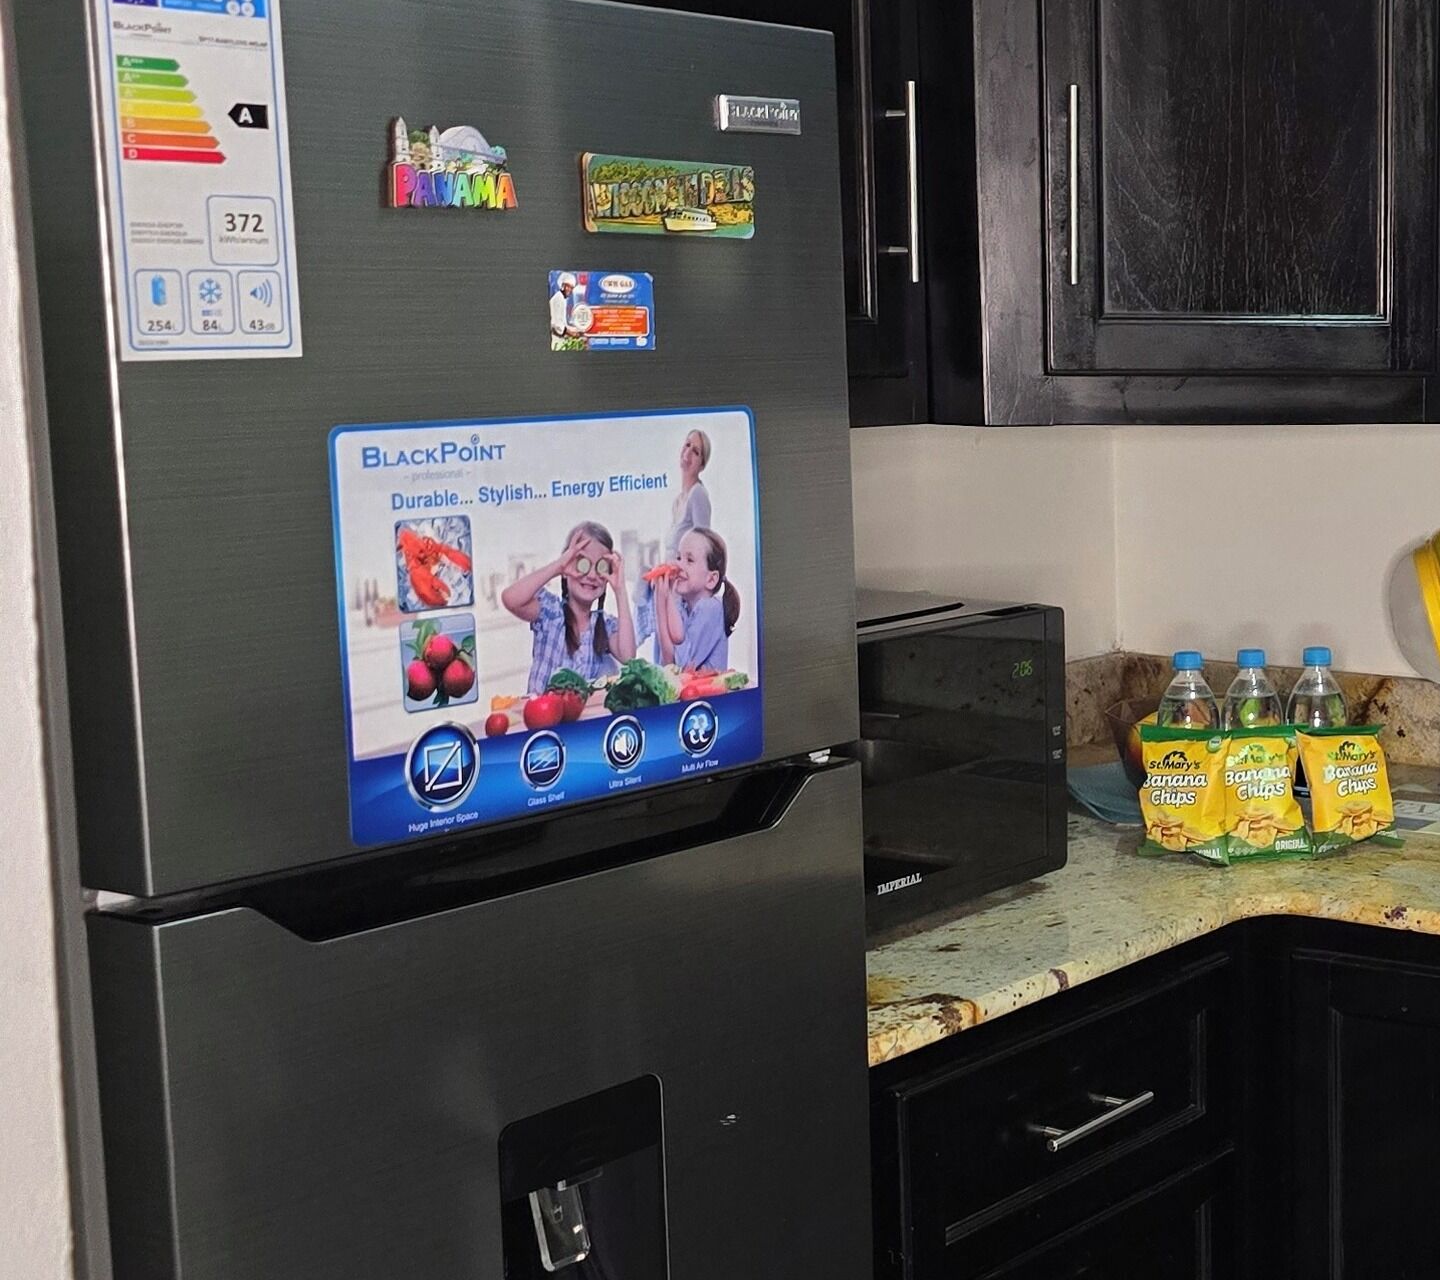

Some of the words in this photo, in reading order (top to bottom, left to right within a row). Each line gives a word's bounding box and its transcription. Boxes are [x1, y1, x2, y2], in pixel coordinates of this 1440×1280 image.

[238, 107, 253, 124] A
[127, 134, 136, 144] C
[128, 149, 138, 159] D
[393, 161, 518, 210] PANAMA
[224, 212, 264, 233] 372
[391, 489, 473, 511] Durable...
[478, 483, 547, 507] Stylish...
[551, 479, 605, 498] Energy
[609, 473, 668, 492] Efficient
[1225, 765, 1291, 787] Banana
[1323, 761, 1378, 784] Banana
[1151, 788, 1197, 808] Chips
[1237, 780, 1286, 801] Chips
[1337, 778, 1377, 798] Chips
[528, 795, 547, 807] Glass
[408, 821, 429, 833] Huge
[456, 811, 479, 824] Space
[877, 872, 922, 896] IMPERIAL
